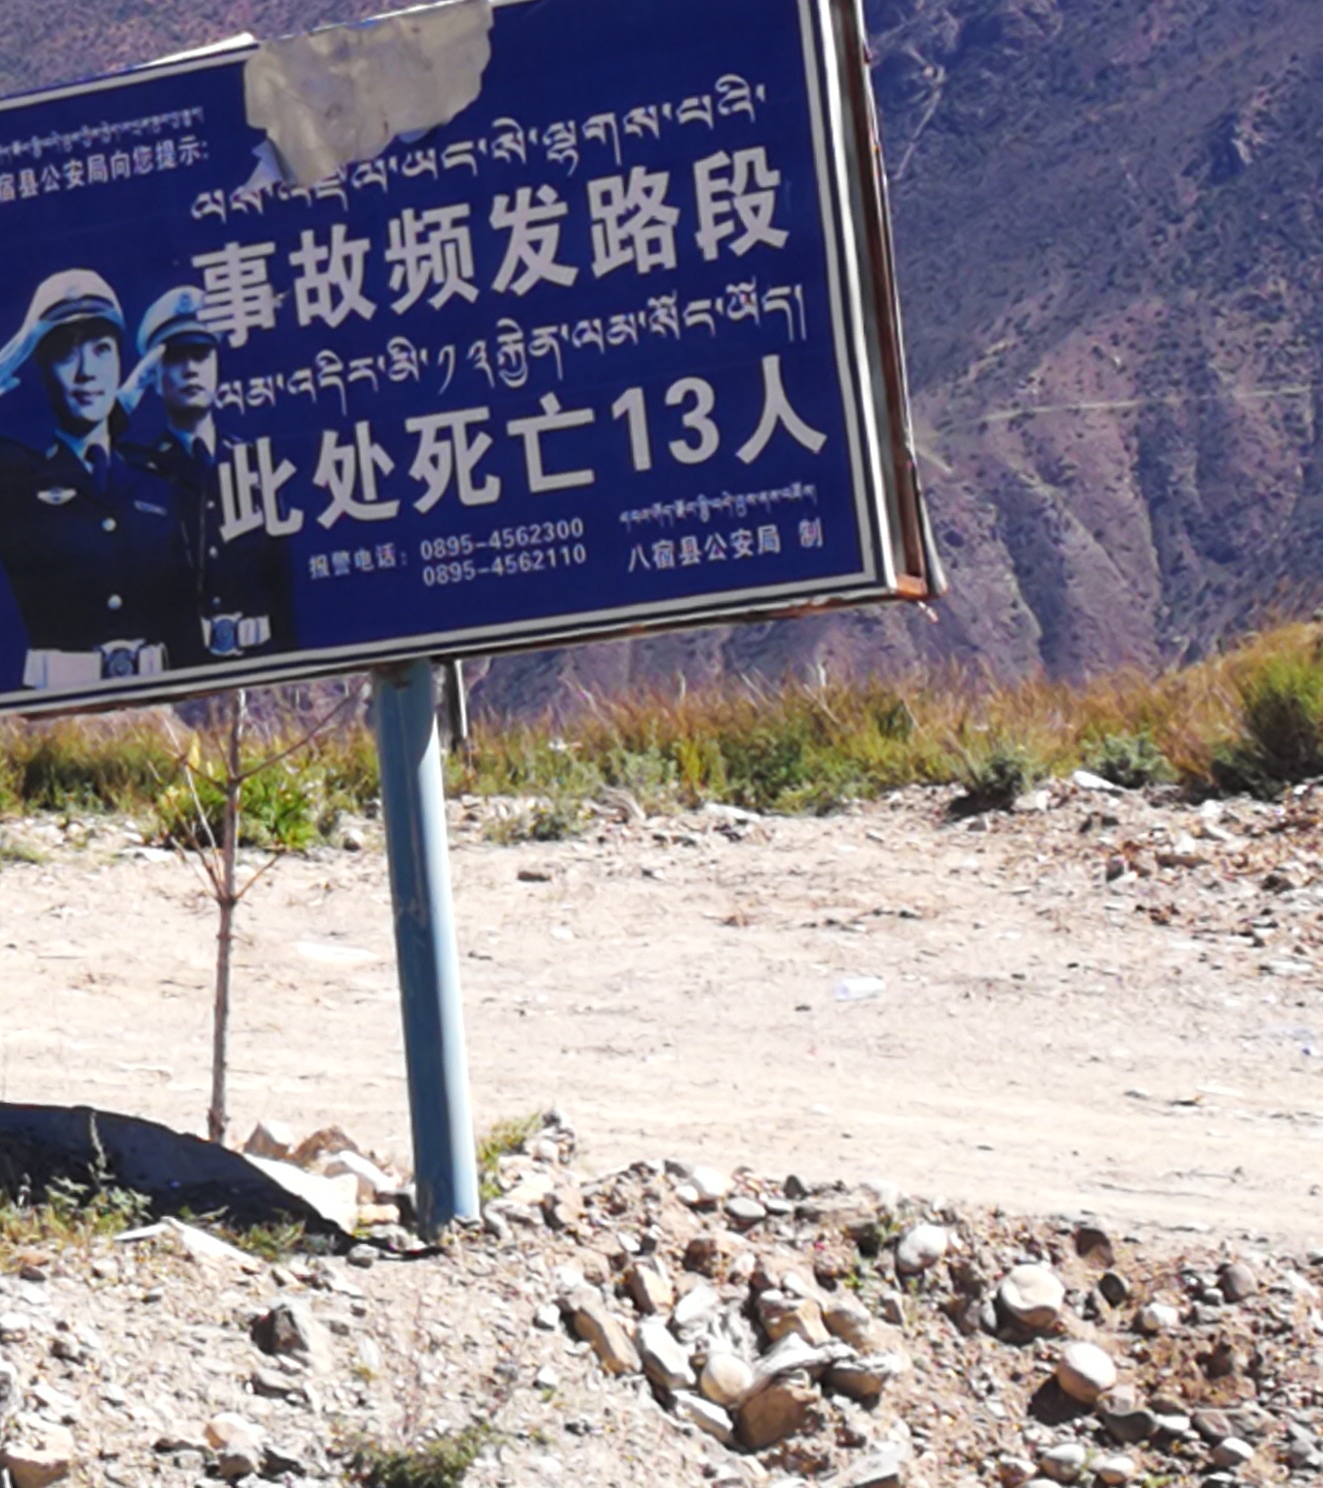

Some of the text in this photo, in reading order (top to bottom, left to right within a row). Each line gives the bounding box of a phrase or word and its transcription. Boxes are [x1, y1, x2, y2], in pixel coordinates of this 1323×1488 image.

[192, 146, 790, 349] 事故频发路段
[217, 355, 828, 544] 此处死亡13人
[309, 517, 584, 580] 报警电话： 0895-4562300
[423, 544, 587, 587] 0895-4562110
[628, 524, 781, 573] 八宿县公安局
